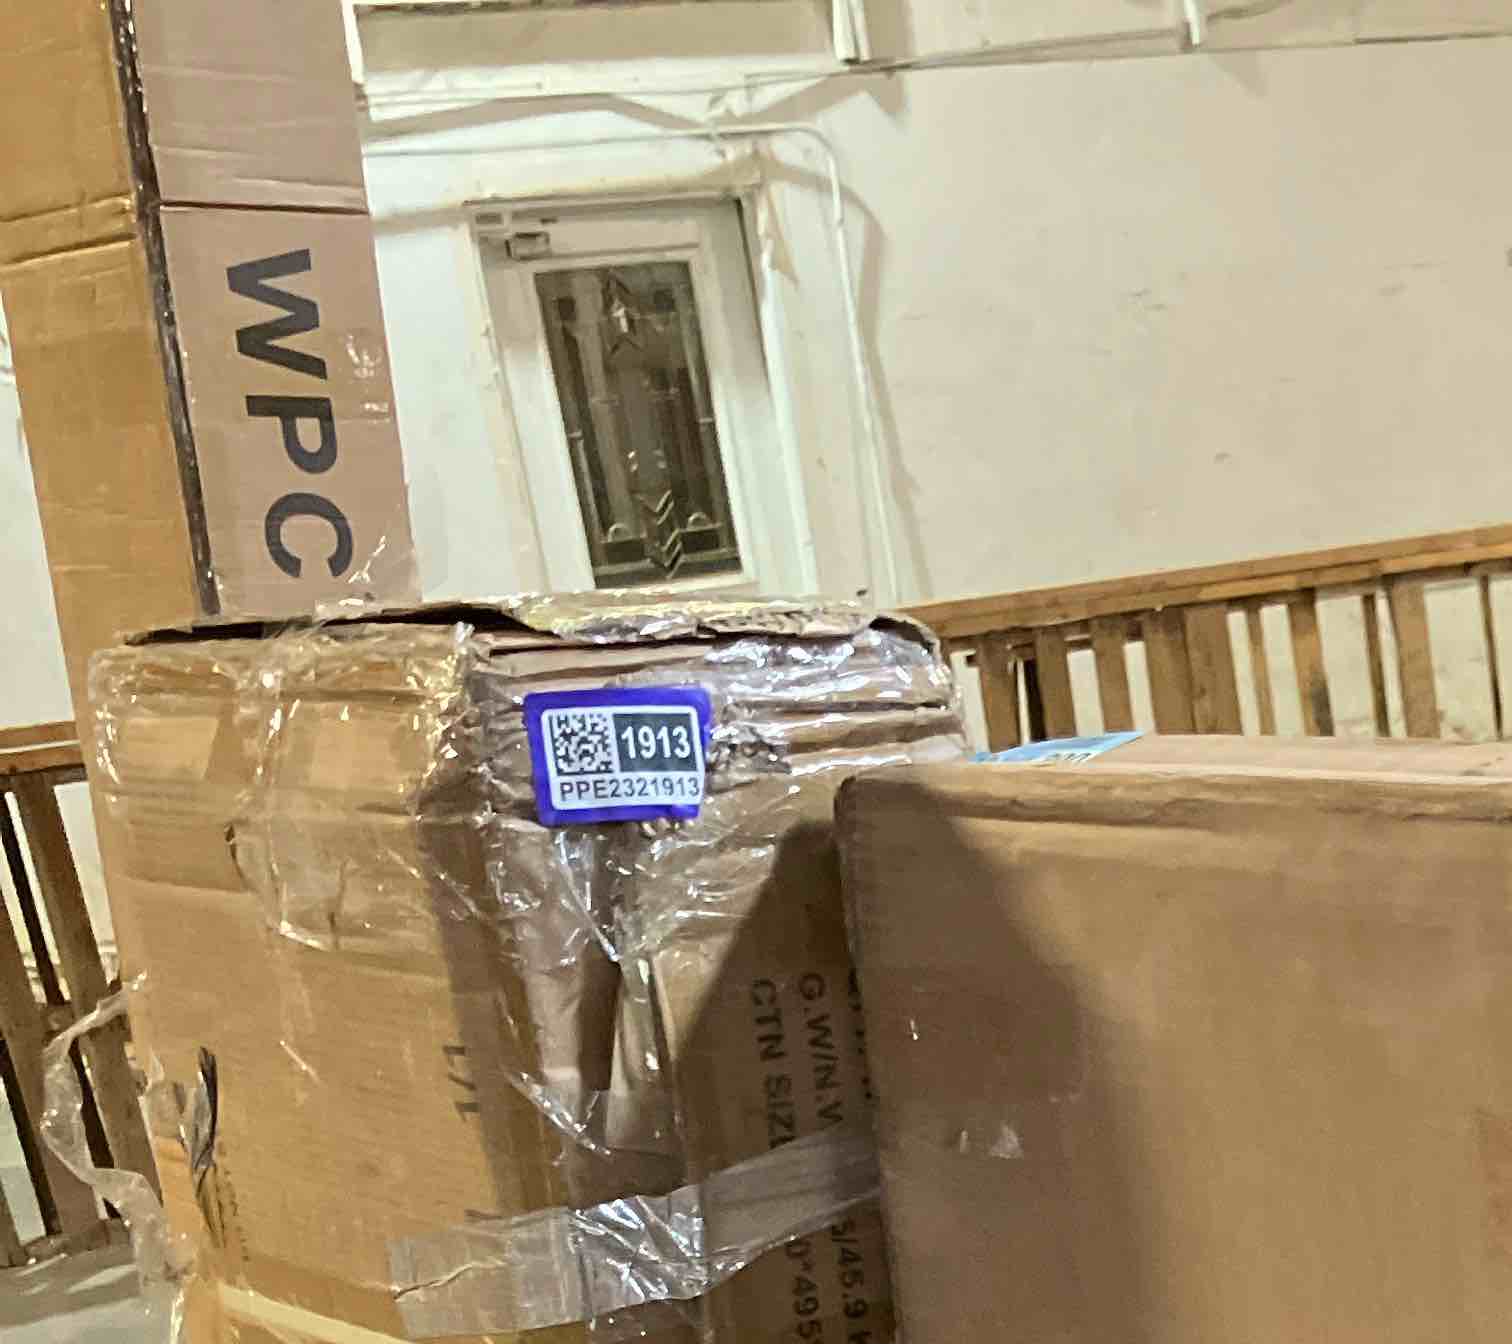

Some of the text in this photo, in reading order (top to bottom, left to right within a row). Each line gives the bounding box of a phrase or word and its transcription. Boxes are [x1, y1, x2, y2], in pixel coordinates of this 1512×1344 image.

[226, 249, 353, 578] WPC
[621, 725, 691, 759] 1913
[560, 777, 701, 801] PPE2321913
[755, 978, 787, 1061] CTN
